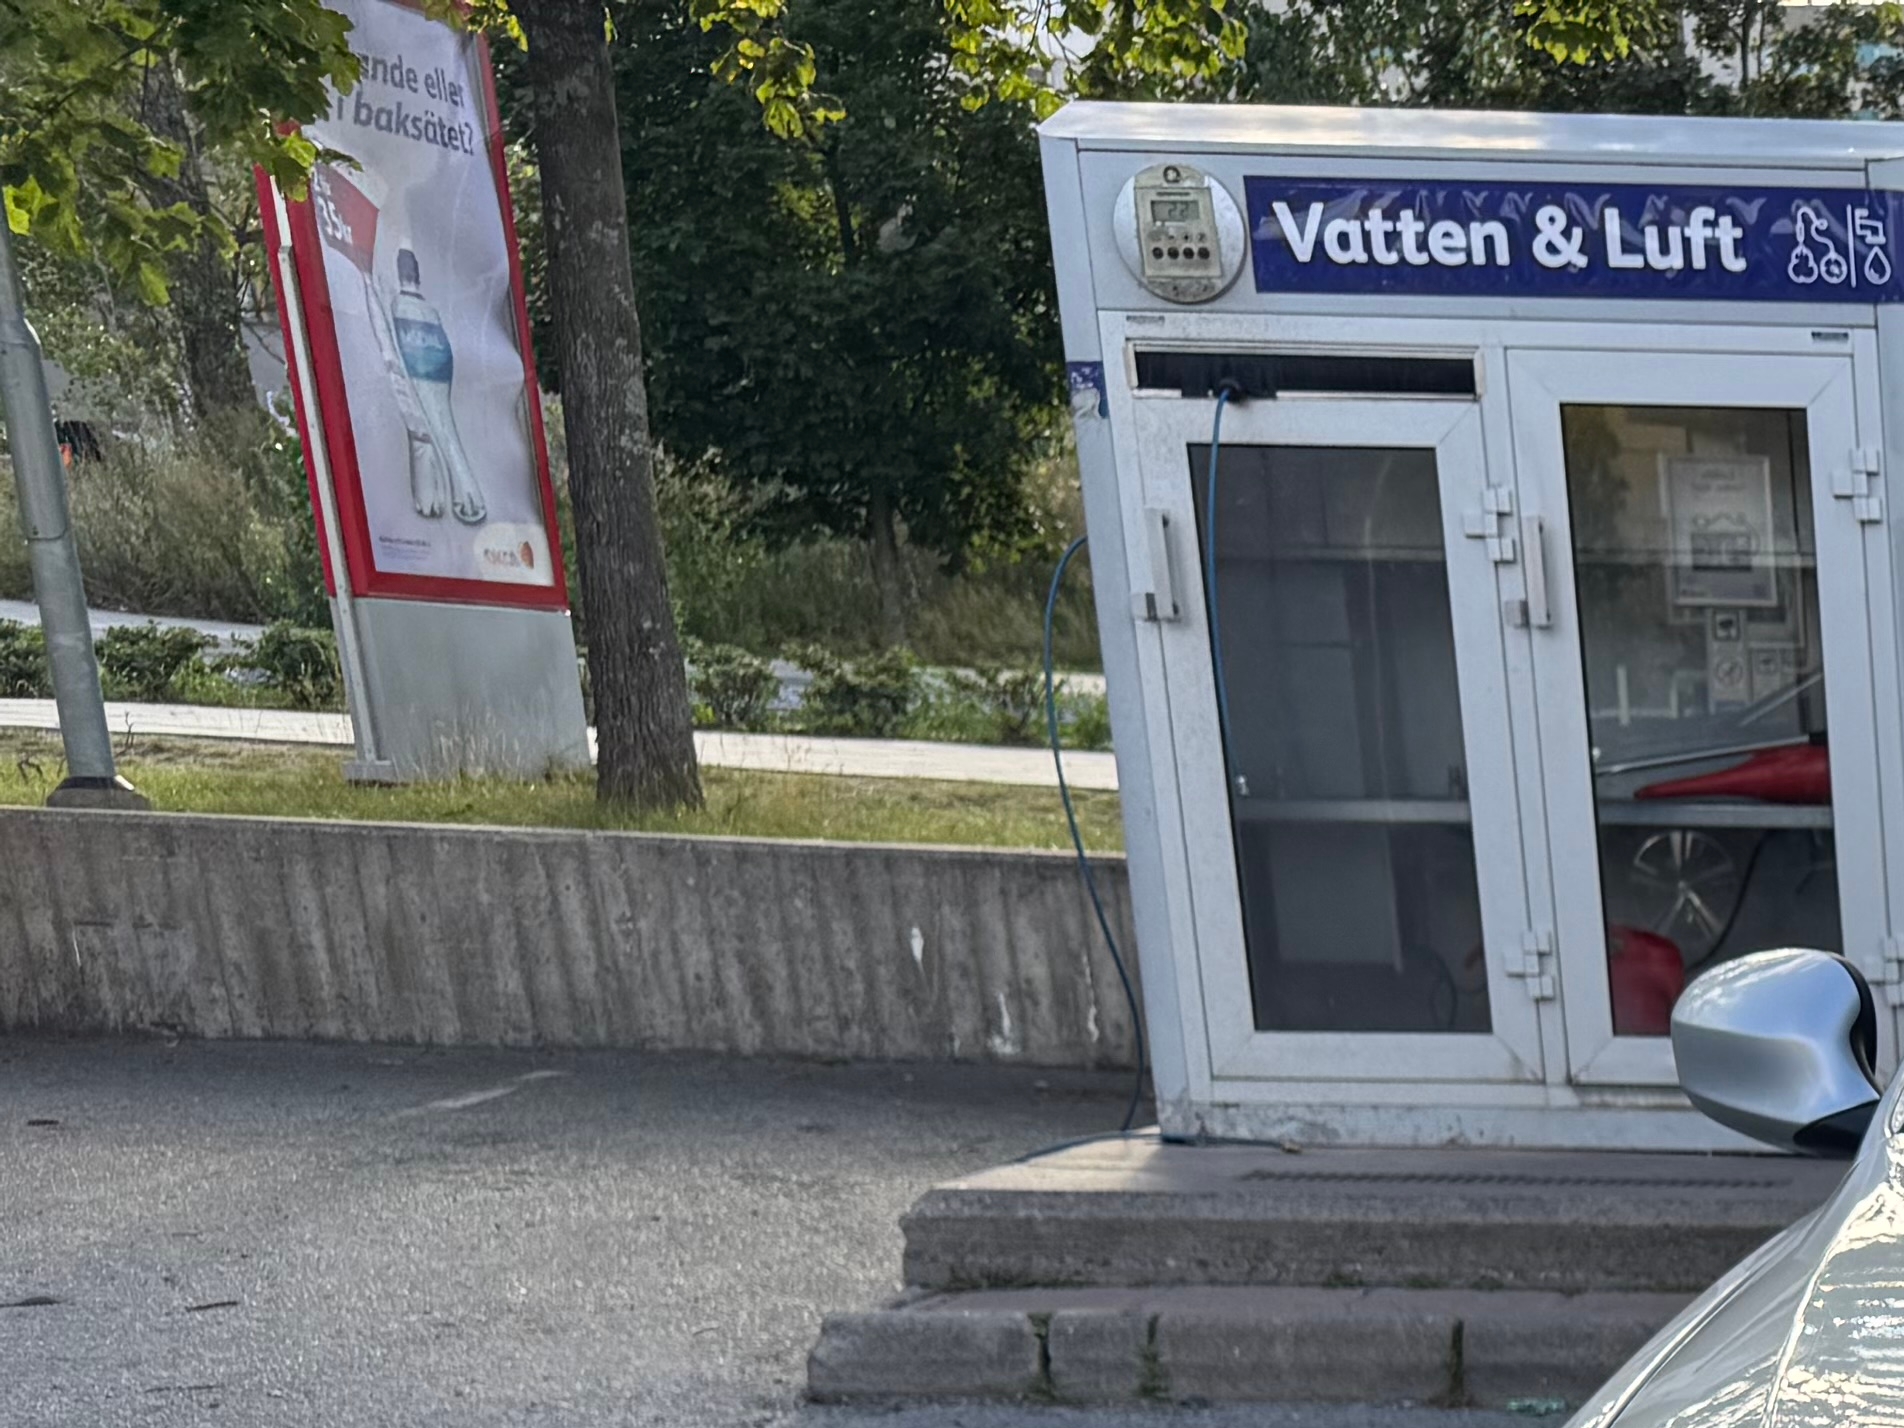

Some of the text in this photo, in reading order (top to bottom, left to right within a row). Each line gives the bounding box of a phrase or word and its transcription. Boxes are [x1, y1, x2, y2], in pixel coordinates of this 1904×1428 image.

[424, 67, 465, 107] eller
[353, 91, 475, 156] baksätet?
[1272, 202, 1748, 273] Vatten & Luft
